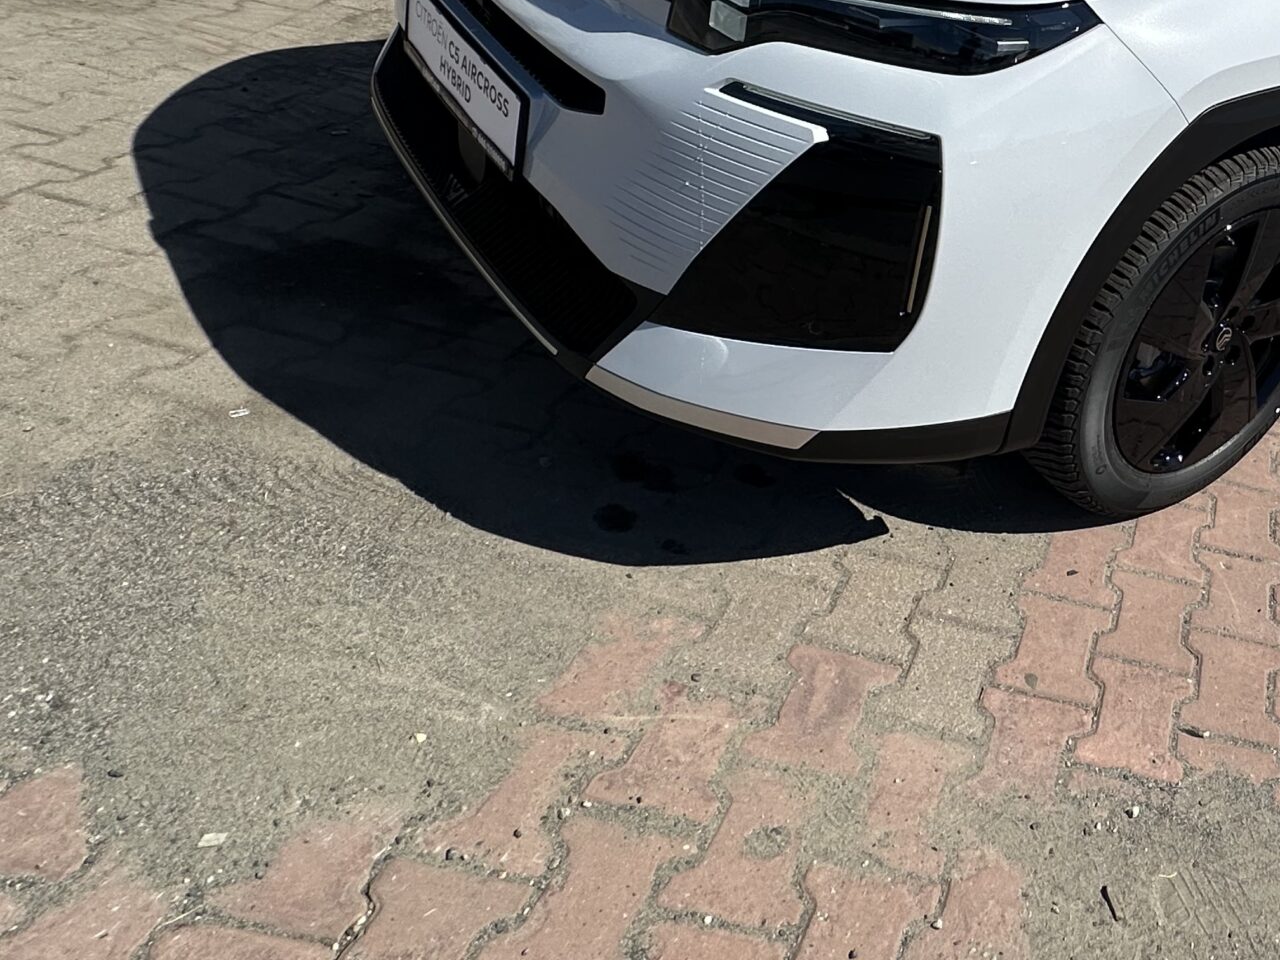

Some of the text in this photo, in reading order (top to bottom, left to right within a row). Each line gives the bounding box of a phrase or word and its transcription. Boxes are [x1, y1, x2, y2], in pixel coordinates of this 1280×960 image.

[440, 55, 471, 103] HYBRID
[448, 40, 460, 65] C5
[461, 55, 509, 118] AIRCROSS
